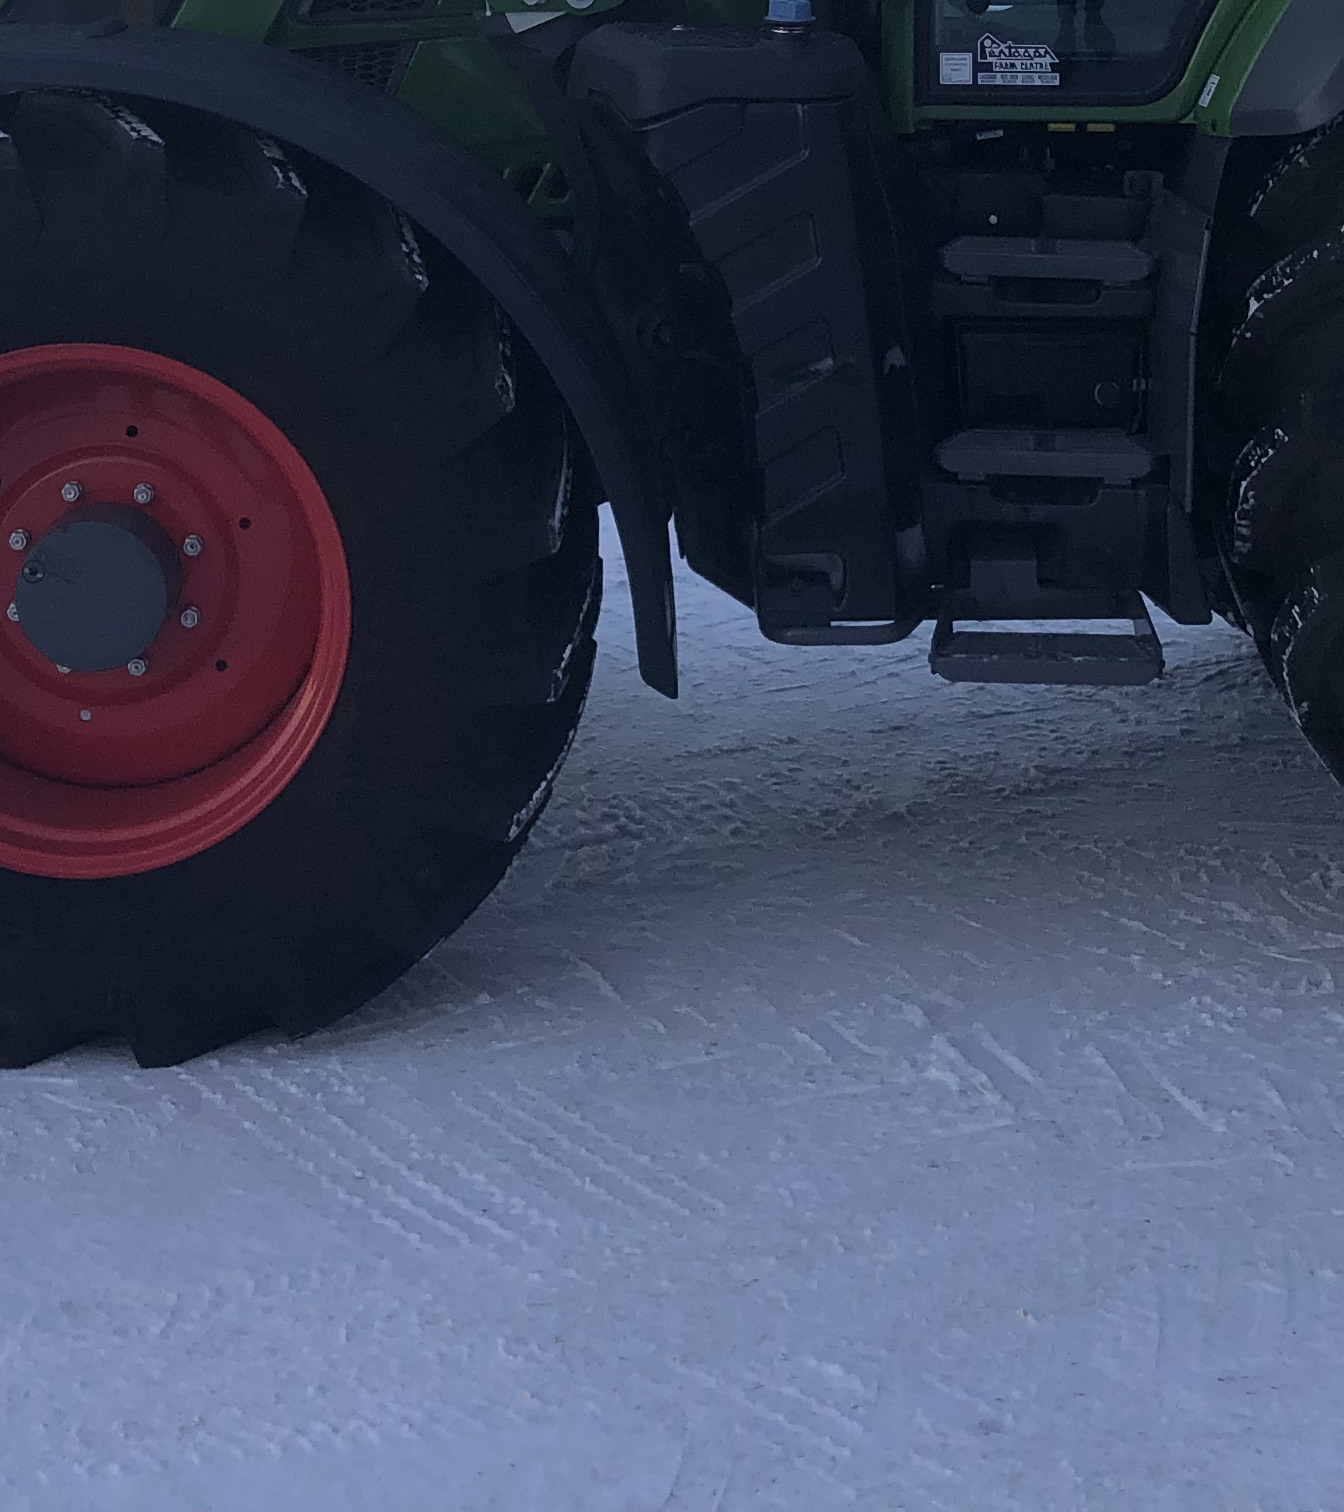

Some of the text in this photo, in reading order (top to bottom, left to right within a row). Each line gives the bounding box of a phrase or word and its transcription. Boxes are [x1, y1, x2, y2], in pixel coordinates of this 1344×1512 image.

[979, 34, 1057, 61] Pentagon
[994, 61, 1051, 70] FARM CENTRE
